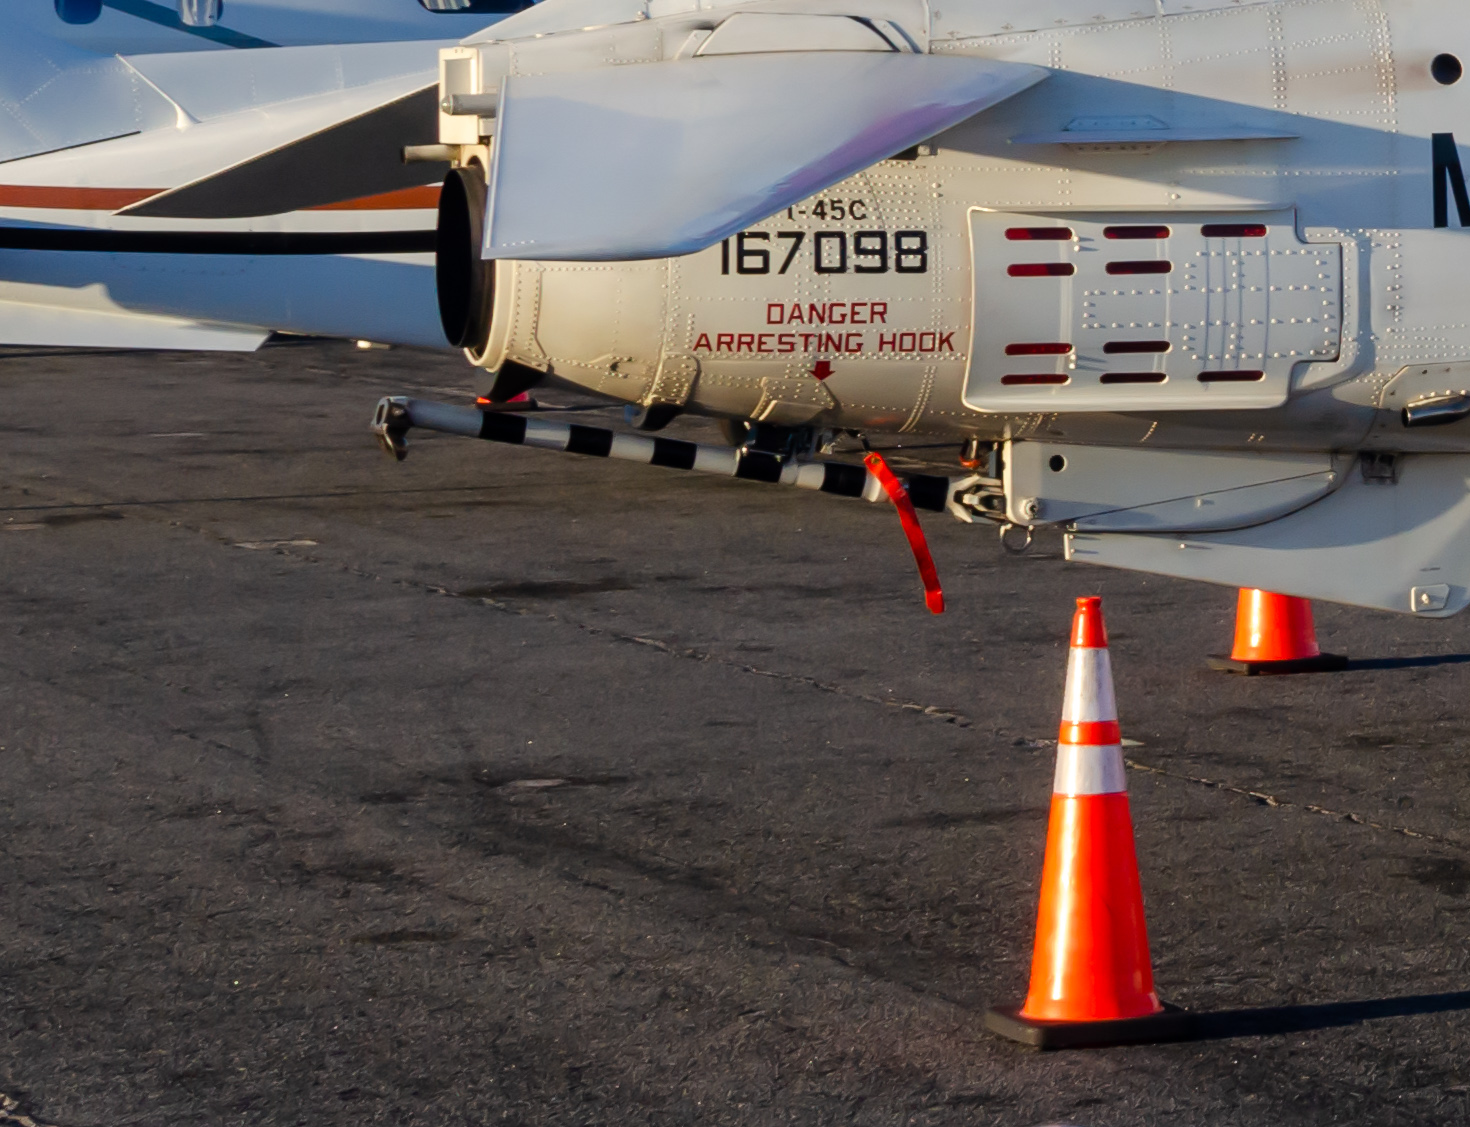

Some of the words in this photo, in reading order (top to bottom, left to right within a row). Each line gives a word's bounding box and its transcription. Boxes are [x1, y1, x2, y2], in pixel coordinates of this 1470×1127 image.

[721, 230, 928, 276] 167098
[766, 302, 888, 325] DANGER
[692, 333, 864, 353] ARRESTING
[878, 332, 956, 352] HOOK
